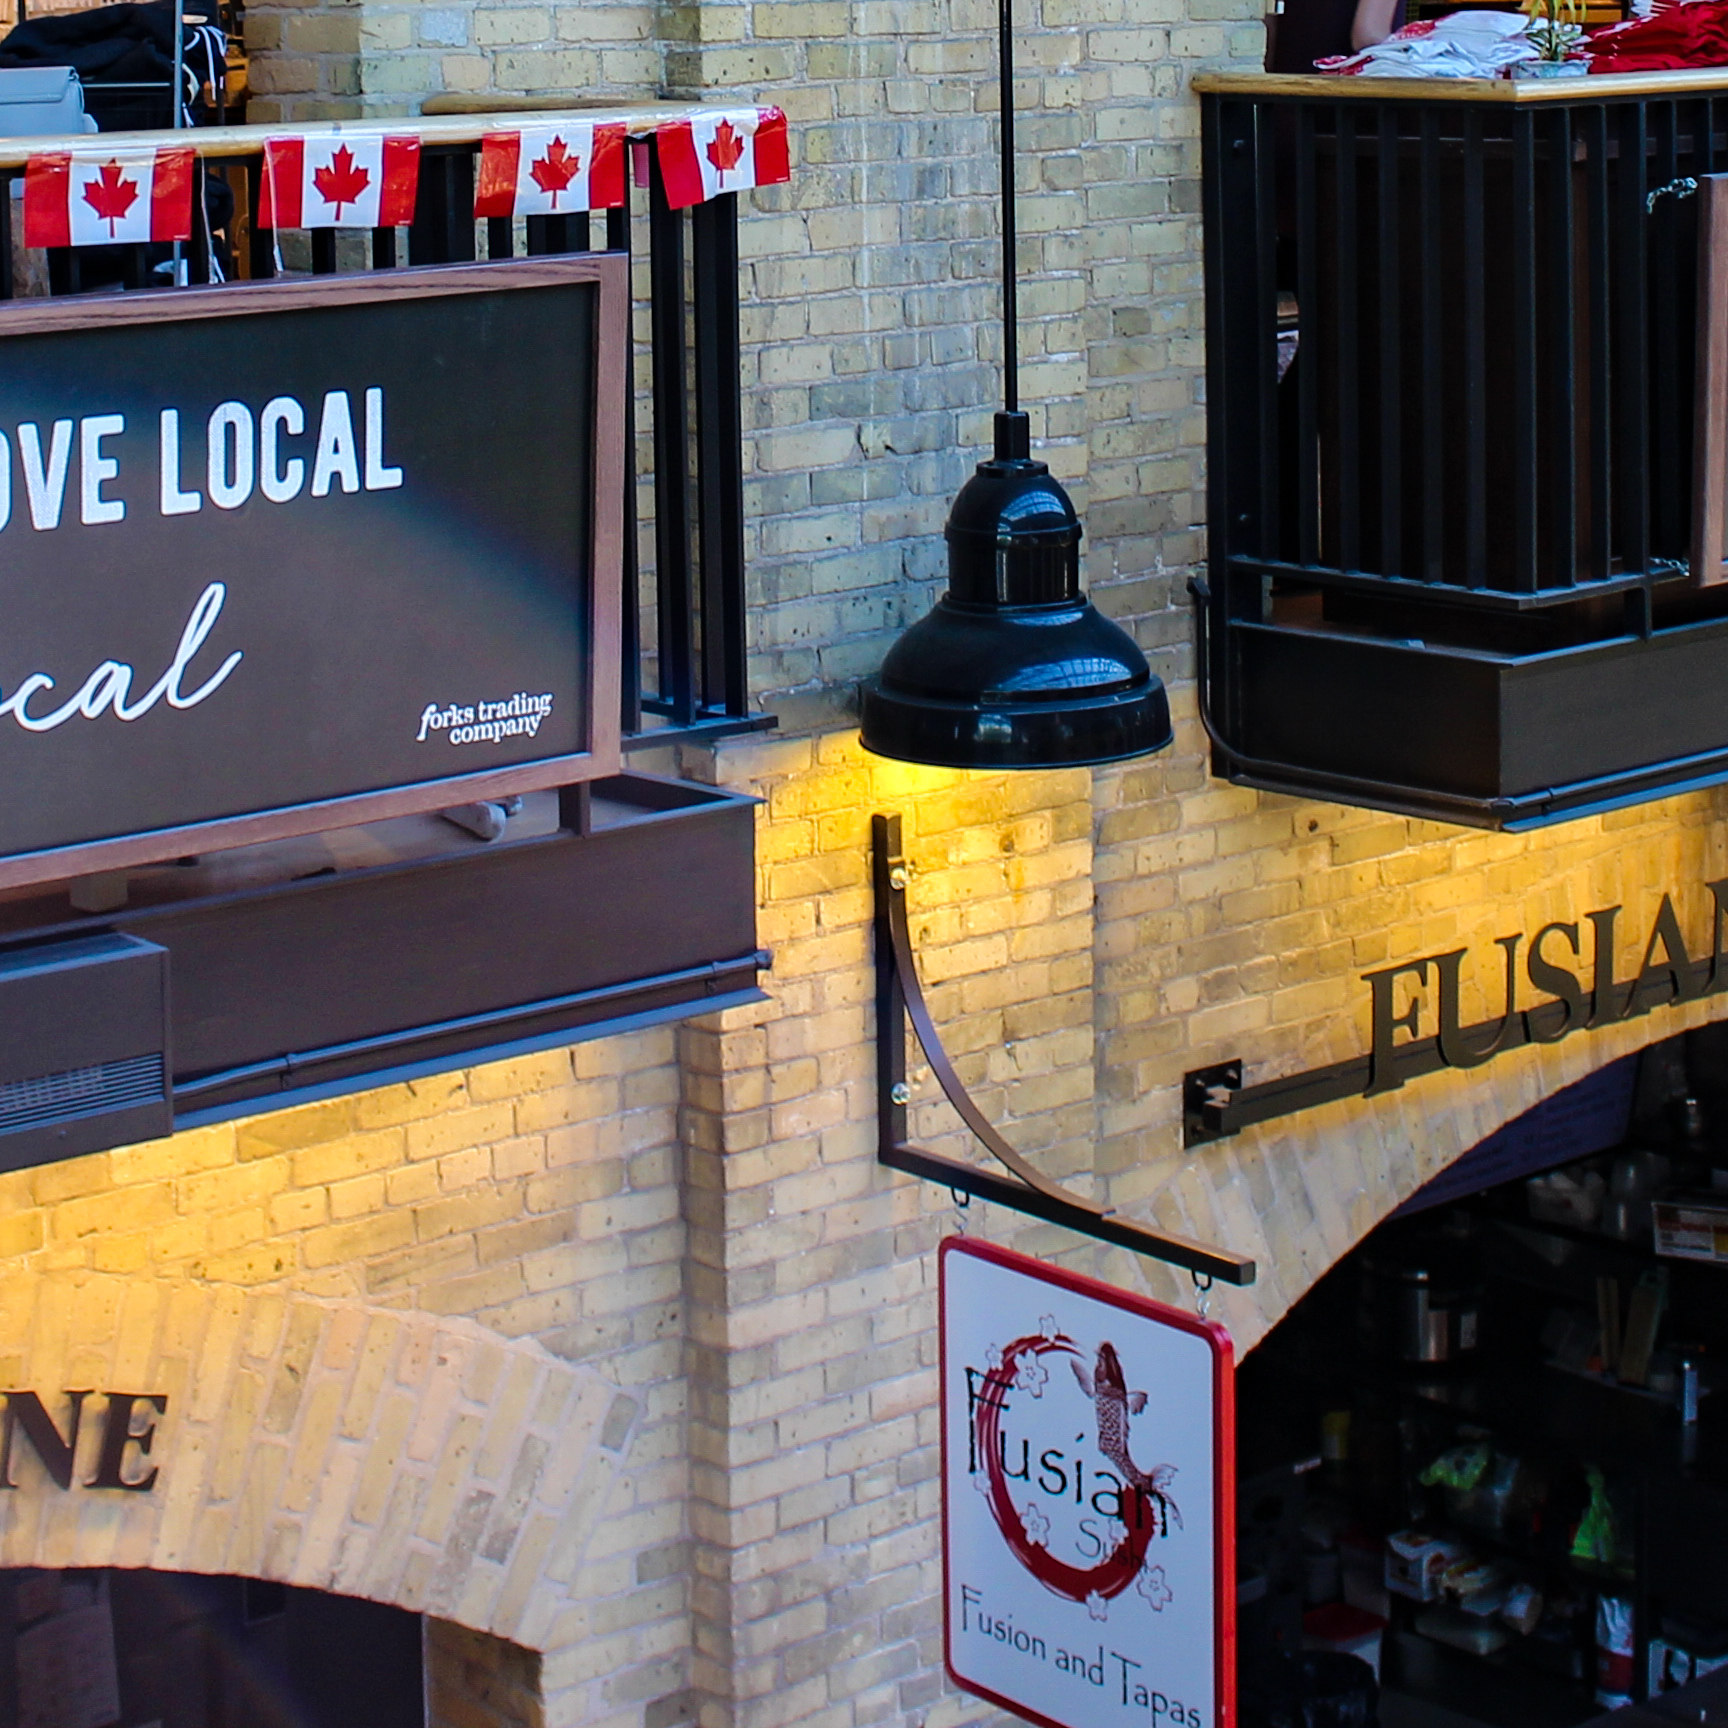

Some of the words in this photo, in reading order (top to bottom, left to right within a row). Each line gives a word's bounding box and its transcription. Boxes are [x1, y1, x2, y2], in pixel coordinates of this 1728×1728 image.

[160, 386, 404, 517] LOCAL
[416, 703, 475, 742] forks
[478, 691, 553, 722] trading
[449, 714, 542, 745] company
[963, 1367, 1169, 1539] Fusian
[1075, 1518, 1149, 1574] Sushi
[960, 1583, 1047, 1662] Fusion
[1055, 1645, 1105, 1687] and
[1111, 1651, 1202, 1728] Tapas
